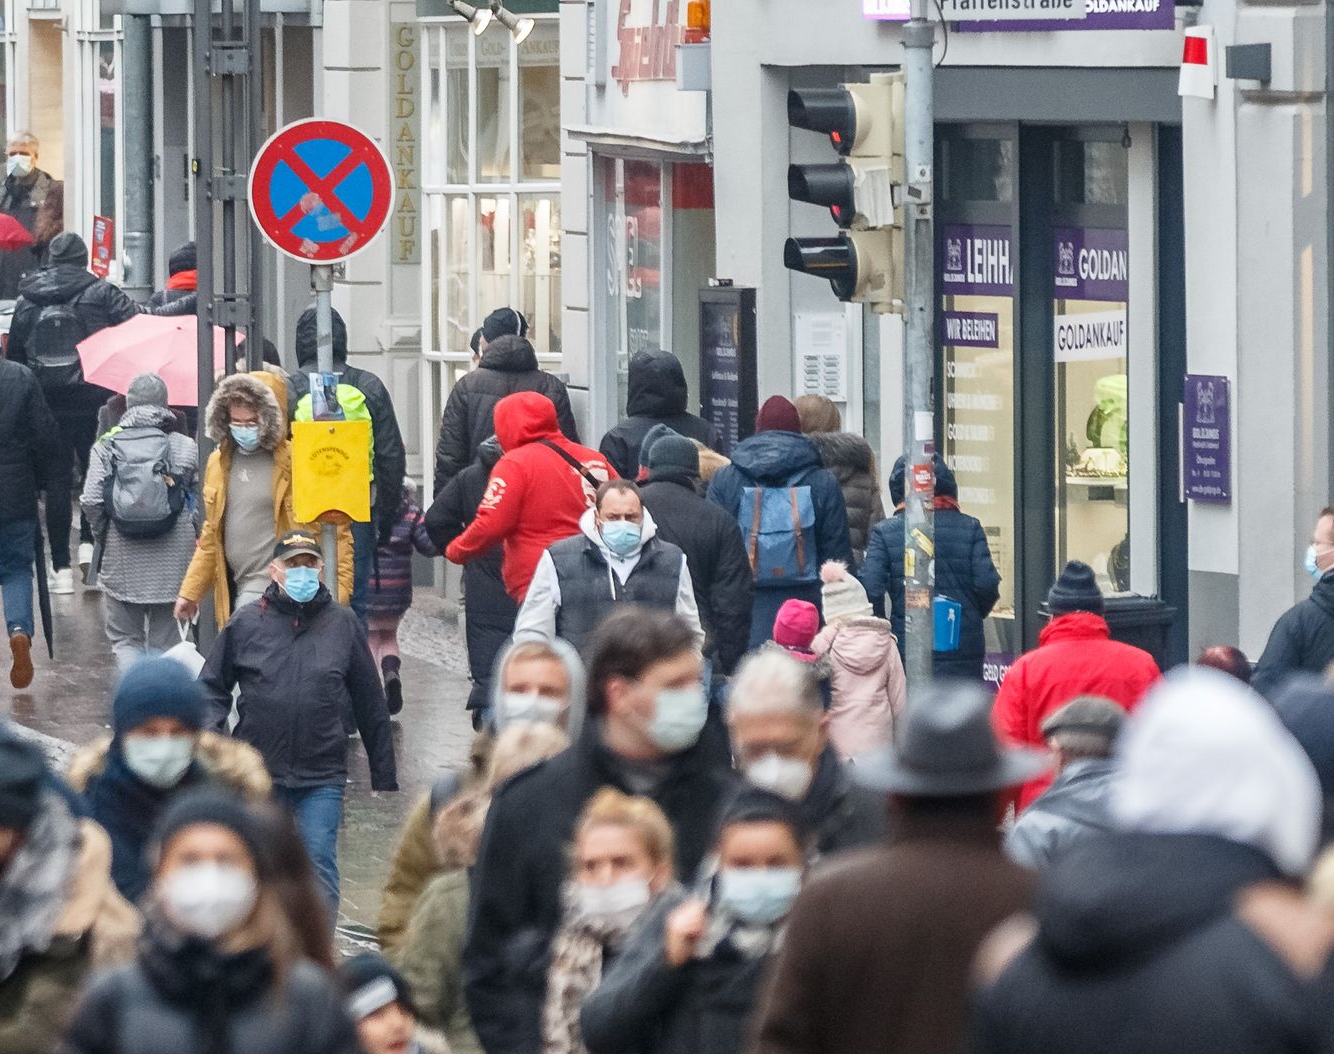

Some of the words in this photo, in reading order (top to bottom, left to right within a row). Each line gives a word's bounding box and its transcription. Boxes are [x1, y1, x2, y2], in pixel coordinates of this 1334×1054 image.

[395, 26, 416, 262] GOLDANKAUF
[1078, 249, 1127, 281] GOLDAN
[947, 318, 961, 340] WIR
[962, 318, 996, 341] BELEIHEN
[1058, 321, 1124, 351] GOLDANKAUF
